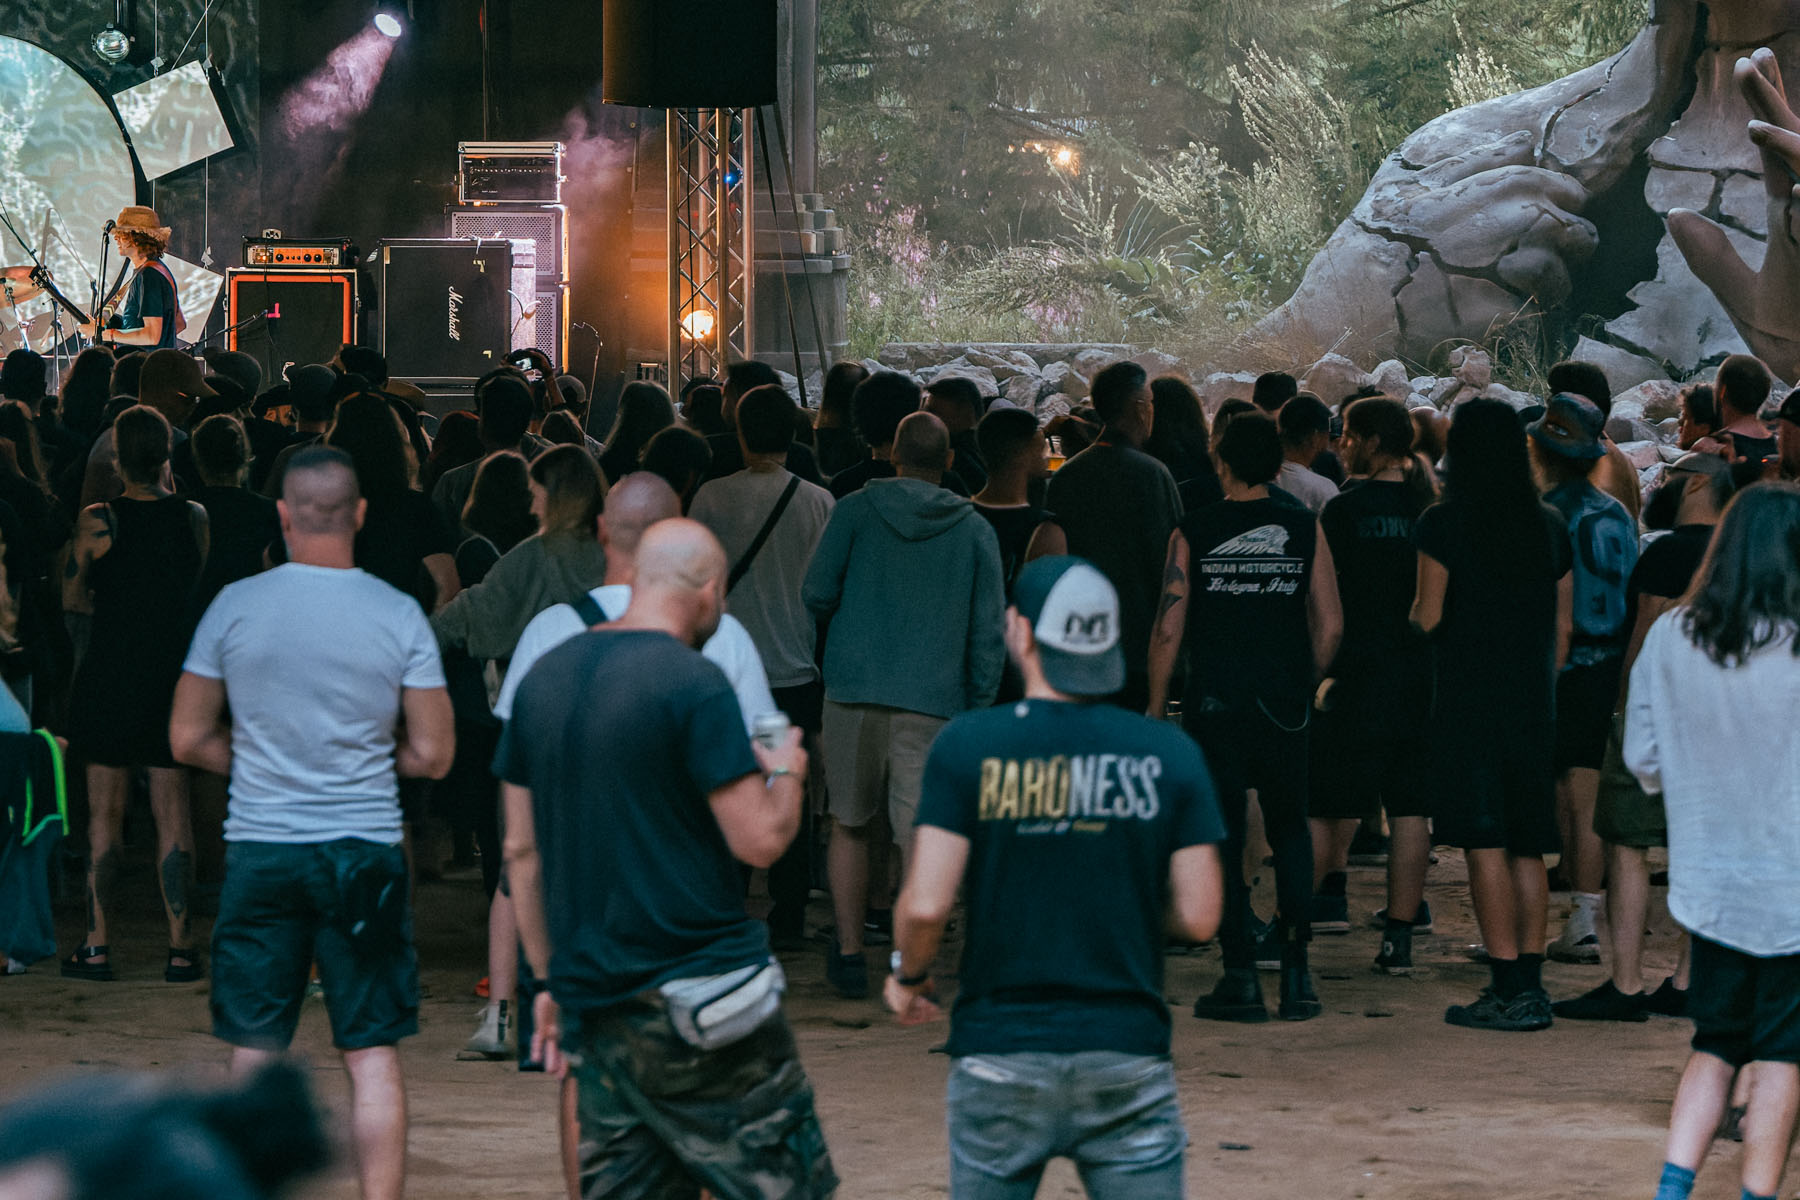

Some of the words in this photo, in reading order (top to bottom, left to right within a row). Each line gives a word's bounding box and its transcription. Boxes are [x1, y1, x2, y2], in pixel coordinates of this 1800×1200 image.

[448, 285, 463, 341] Marshall
[1201, 563, 1237, 574] INDIAN
[1238, 562, 1304, 574] MOTORCYCLE
[1266, 576, 1299, 595] Italy
[978, 753, 1162, 821] BARONESS
